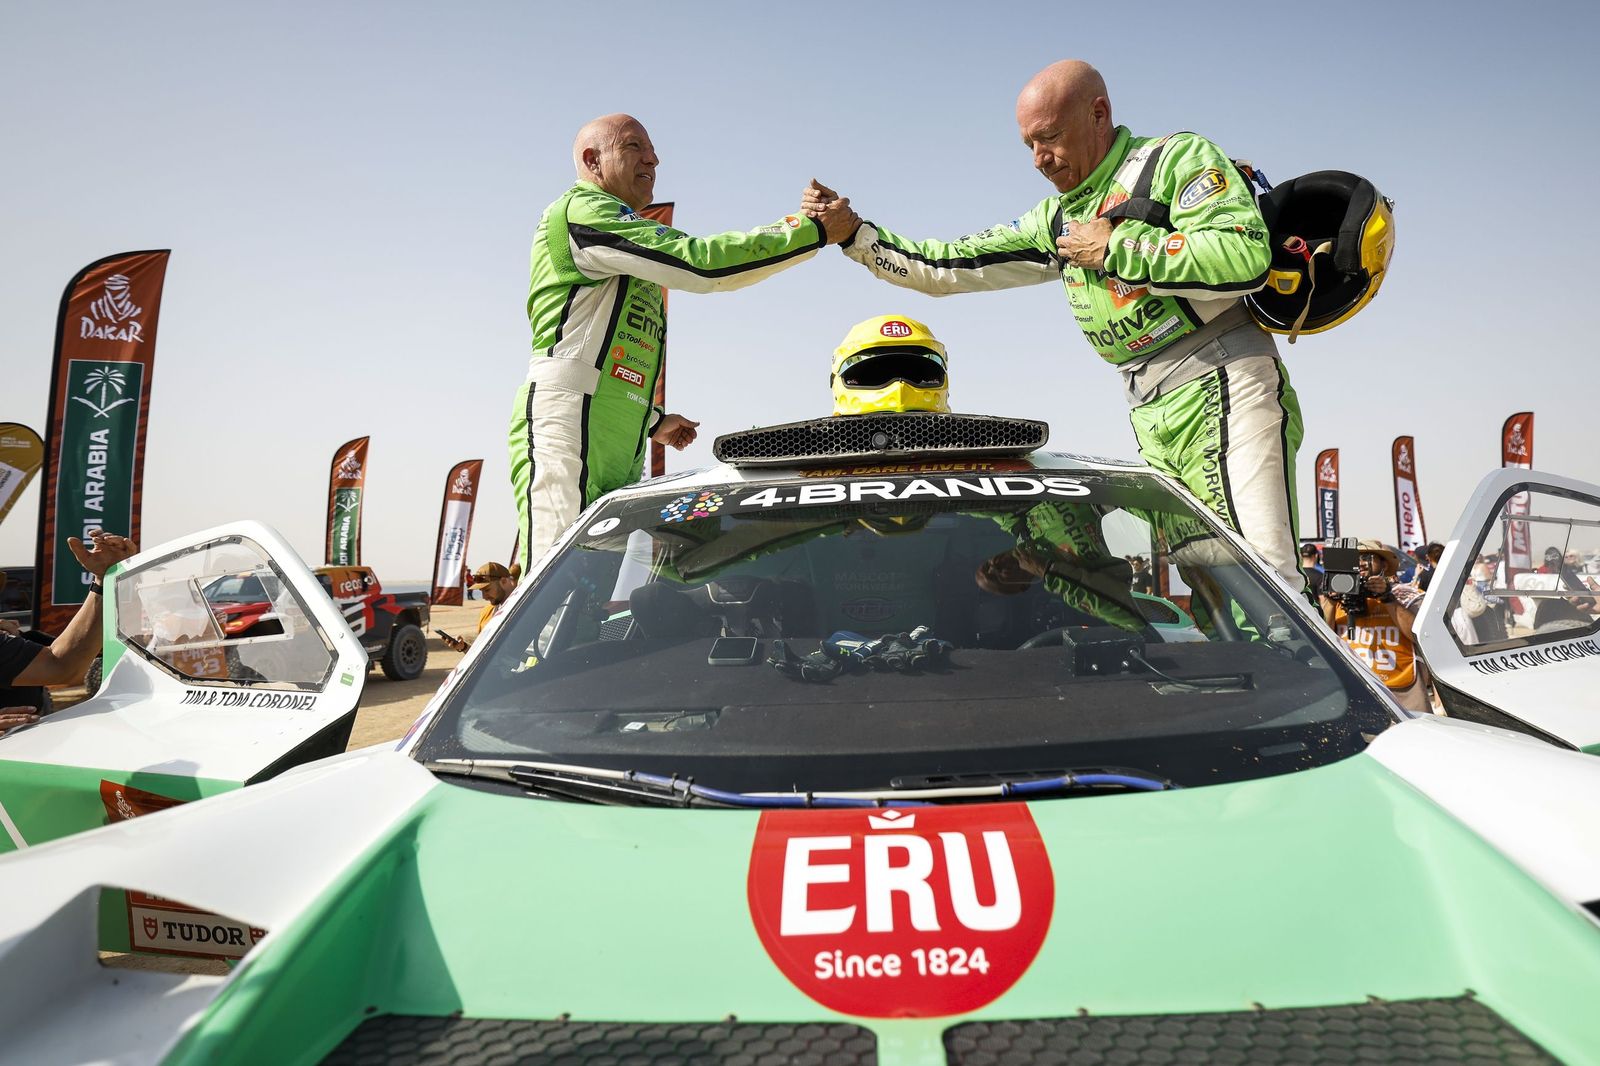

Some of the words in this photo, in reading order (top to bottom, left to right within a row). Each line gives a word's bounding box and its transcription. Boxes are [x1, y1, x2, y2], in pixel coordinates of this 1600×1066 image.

[1068, 186, 1094, 204] LKQ
[1184, 172, 1226, 206] HELLA
[80, 316, 144, 343] DAKAR
[883, 325, 910, 335] ERU
[615, 366, 643, 386] FEBO
[84, 428, 110, 511] ARABIA
[852, 465, 914, 475] DARE.
[920, 463, 970, 471] LIVE
[1402, 491, 1415, 536] Hero
[340, 515, 351, 549] ARABIA
[1469, 657, 1508, 675] TIM
[1500, 655, 1520, 670] &
[1510, 649, 1551, 668] TOM
[180, 690, 208, 705] TIM
[204, 691, 218, 705] &
[215, 691, 251, 707] TOM
[249, 693, 317, 711] CORONEL
[780, 830, 1022, 936] ERU
[163, 921, 246, 946] TUDOR
[814, 949, 901, 979] Since
[911, 947, 990, 976] 1824
